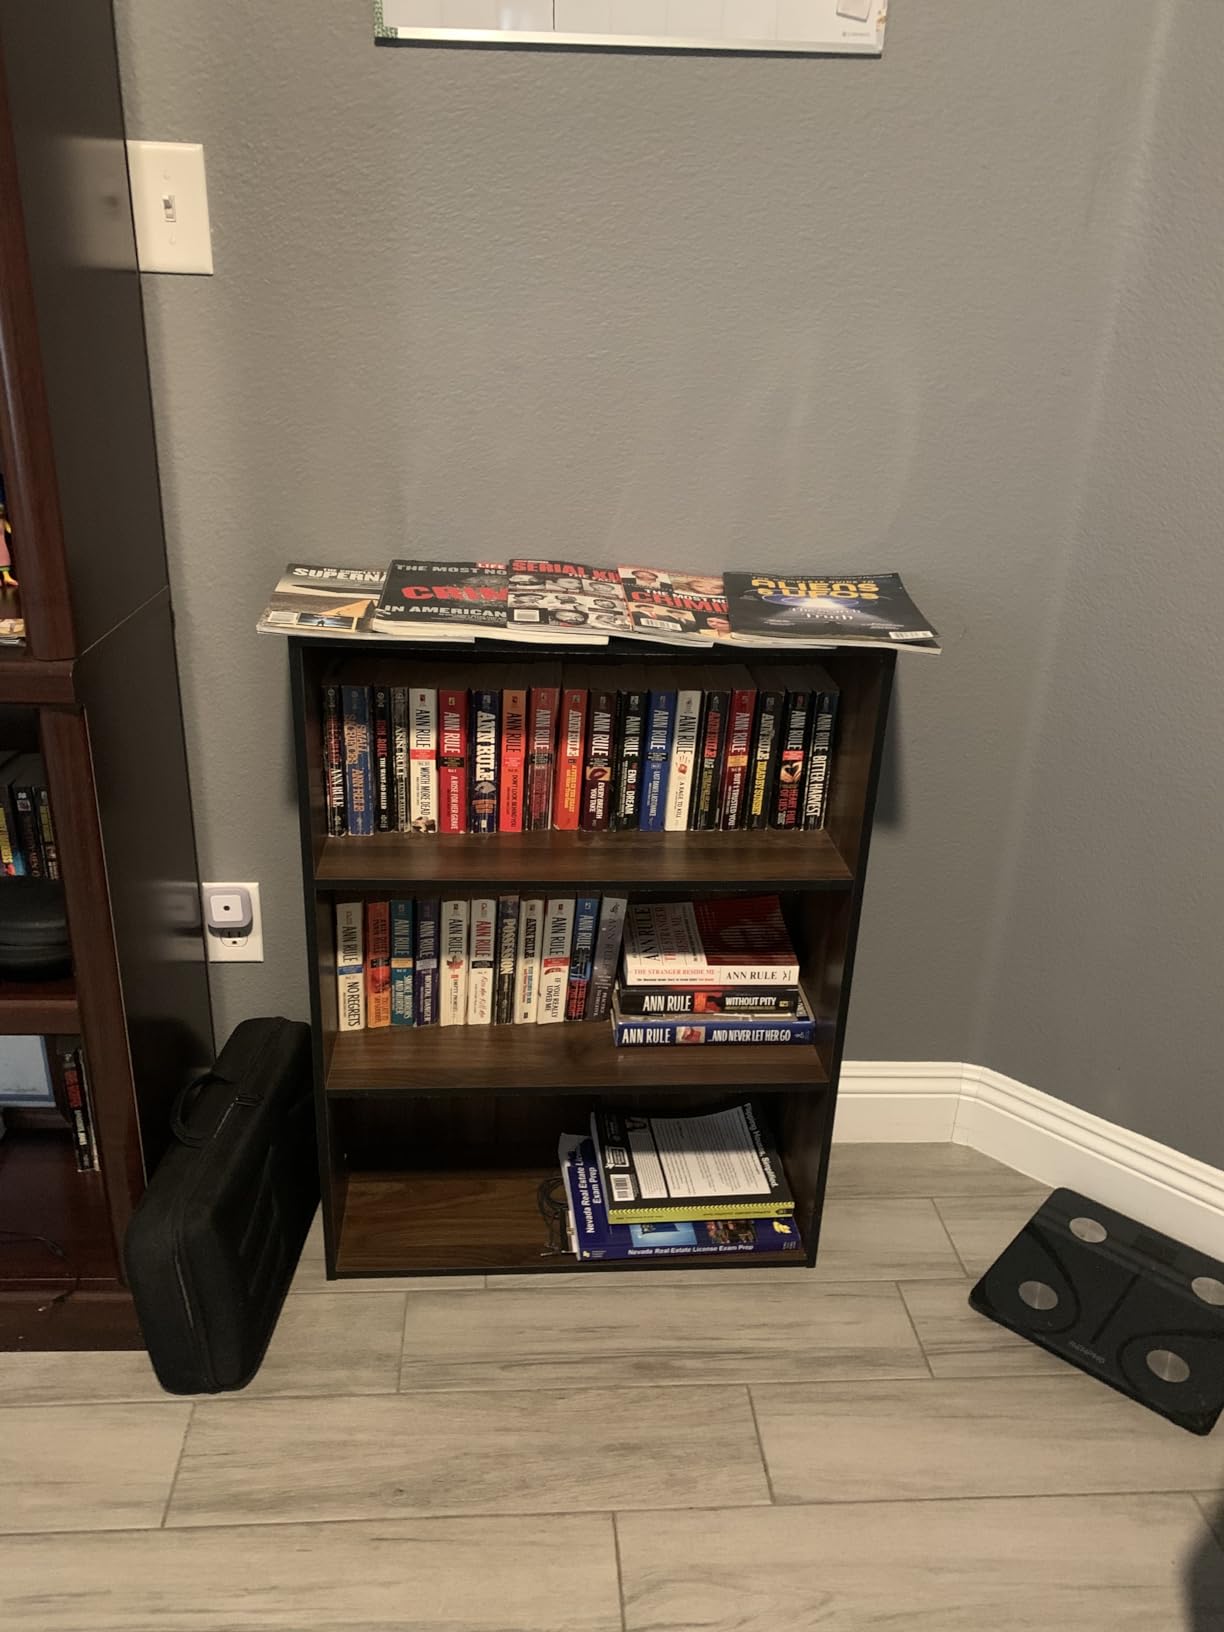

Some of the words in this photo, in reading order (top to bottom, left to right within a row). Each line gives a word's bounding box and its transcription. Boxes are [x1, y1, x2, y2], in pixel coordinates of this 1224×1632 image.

[395, 564, 428, 572] THE
[432, 566, 480, 574] MOST
[484, 568, 508, 576] NO
[512, 560, 586, 577] SERIAL
[751, 579, 880, 593] ALIENS
[384, 605, 405, 613] IN
[408, 606, 508, 618] AMERICAN
[415, 709, 430, 726] ANN
[444, 712, 460, 731] ANN
[506, 712, 522, 732] ANN
[536, 708, 551, 728] ANN
[568, 710, 582, 733] ANN
[593, 712, 610, 732] ANN
[625, 716, 640, 734] ANN
[653, 710, 668, 728] ANN
[678, 715, 696, 735] ANN
[708, 712, 720, 734] ANN
[734, 712, 750, 732] ANN
[760, 713, 775, 736] ANN
[790, 710, 806, 729] ANN
[816, 714, 832, 732] ANN
[395, 726, 405, 749] ANN
[476, 711, 496, 745] ANN
[344, 714, 358, 764] SACRIFICES
[357, 724, 368, 755] SMALL
[415, 728, 430, 748] RULE
[444, 732, 460, 754] RULE
[506, 733, 522, 753] RULE
[534, 729, 550, 750] RULE
[566, 732, 580, 757] RULE
[592, 734, 609, 756] RULE
[623, 736, 640, 757] RULE
[650, 729, 666, 750] RULE
[676, 735, 694, 754] RULE
[704, 734, 718, 758] RULE
[732, 732, 748, 753] RULE
[788, 730, 804, 750] RULE
[814, 732, 830, 752] RULE
[756, 736, 772, 760] RULE
[395, 752, 405, 778] RULE
[476, 745, 496, 781] RULE
[756, 761, 768, 780] DEAD
[810, 756, 827, 782] BITTER
[331, 768, 344, 786] ANN
[352, 768, 364, 788] ANN
[420, 766, 430, 784] WORTH
[628, 770, 636, 784] END
[755, 780, 766, 788] BY
[420, 785, 430, 800] MORE
[450, 780, 458, 792] ROSE
[780, 789, 789, 798] OF
[332, 786, 344, 808] RULE
[352, 788, 365, 812] RULE
[450, 794, 458, 802] FOR
[625, 790, 634, 815] DREAM
[730, 789, 740, 814] TRUSTED
[752, 788, 764, 816] SUNSET
[778, 798, 788, 812] LIES
[788, 788, 798, 808] HEART
[806, 784, 823, 816] HARVEST
[420, 802, 430, 816] DEAD
[450, 803, 458, 814] HER
[596, 798, 604, 820] BREATH
[786, 810, 796, 824] FULL
[450, 814, 458, 830] GRAVE
[728, 814, 736, 826] YOU
[373, 919, 388, 936] ANN
[394, 919, 409, 936] ANN
[420, 920, 434, 938] ANN
[449, 918, 464, 936] ANN
[476, 920, 492, 936] ANN
[526, 918, 537, 937] ANN
[551, 917, 566, 934] ANN
[579, 915, 594, 932] ANN
[634, 907, 654, 936] RULE
[342, 926, 358, 943] ANN
[576, 932, 592, 950] RULE
[343, 944, 358, 962] RULE
[373, 936, 388, 954] RULE
[395, 936, 409, 955] RULE
[420, 938, 434, 958] RULE
[448, 936, 463, 955] RULE
[475, 939, 490, 958] RULE
[500, 918, 517, 974] POSSESSION
[524, 937, 536, 959] RULE
[550, 936, 565, 955] RULE
[640, 937, 660, 961] ANN
[396, 980, 404, 990] AND
[424, 975, 432, 996] MORTAL
[726, 972, 747, 980] ANN
[750, 972, 777, 980] RULE
[347, 982, 360, 994] NO
[546, 985, 554, 1002] LOVED
[552, 984, 560, 996] YOU
[348, 994, 360, 1026] REGRETS
[396, 992, 404, 1014] MURDER
[404, 994, 412, 1020] MIRRORS
[424, 998, 432, 1022] DANGER
[545, 1003, 552, 1011] ME
[642, 995, 665, 1012] ANN
[666, 995, 692, 1012] RULE
[725, 996, 759, 1006] WITHOUT
[760, 996, 777, 1006] PITY
[622, 1028, 644, 1044] ANN
[646, 1028, 671, 1044] RULE
[728, 1030, 752, 1042] NEVER
[752, 1030, 764, 1042] LET
[764, 1030, 780, 1041] HER
[780, 1030, 792, 1041] GO
[578, 1168, 588, 1188] Estate
[589, 1167, 598, 1183] Prep
[581, 1190, 590, 1206] Real
[592, 1184, 602, 1204] Exam
[583, 1207, 596, 1234] Nevada
